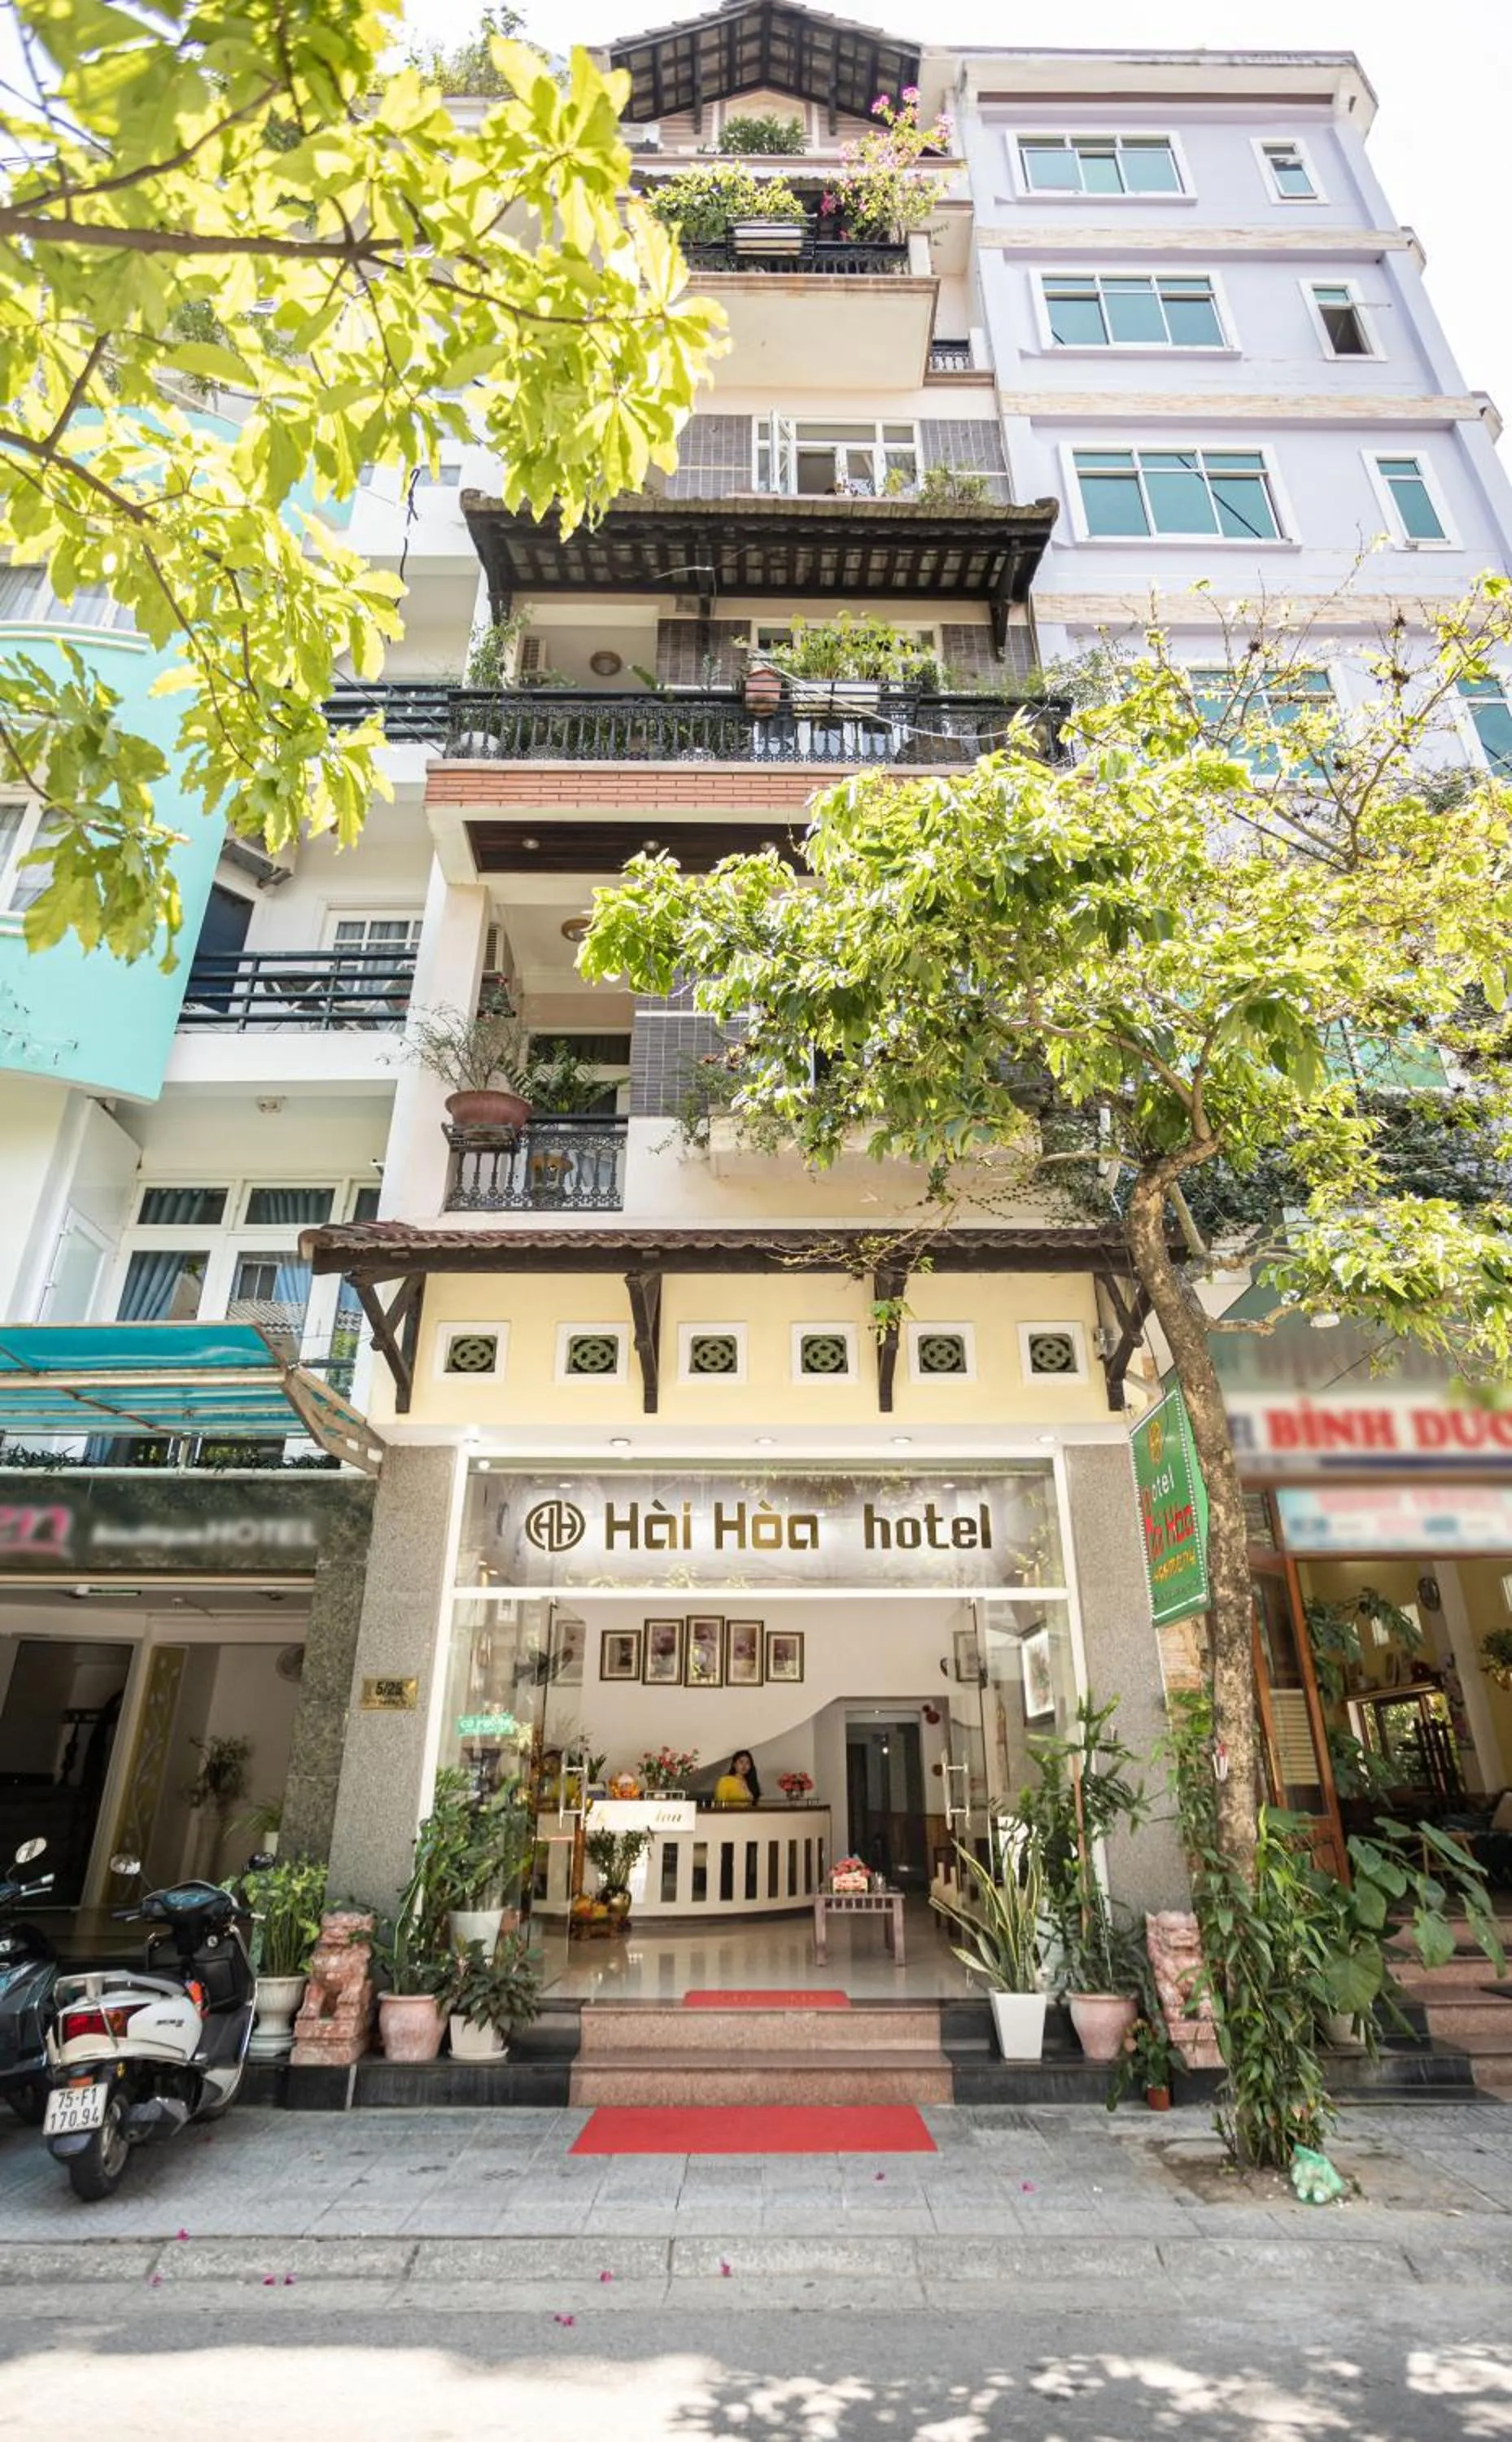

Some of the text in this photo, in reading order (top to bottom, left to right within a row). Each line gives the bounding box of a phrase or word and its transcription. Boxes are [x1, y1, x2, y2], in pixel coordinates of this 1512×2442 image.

[605, 1499, 692, 1550] Hài
[714, 1499, 819, 1550] Hòa
[864, 1503, 992, 1550] hotel
